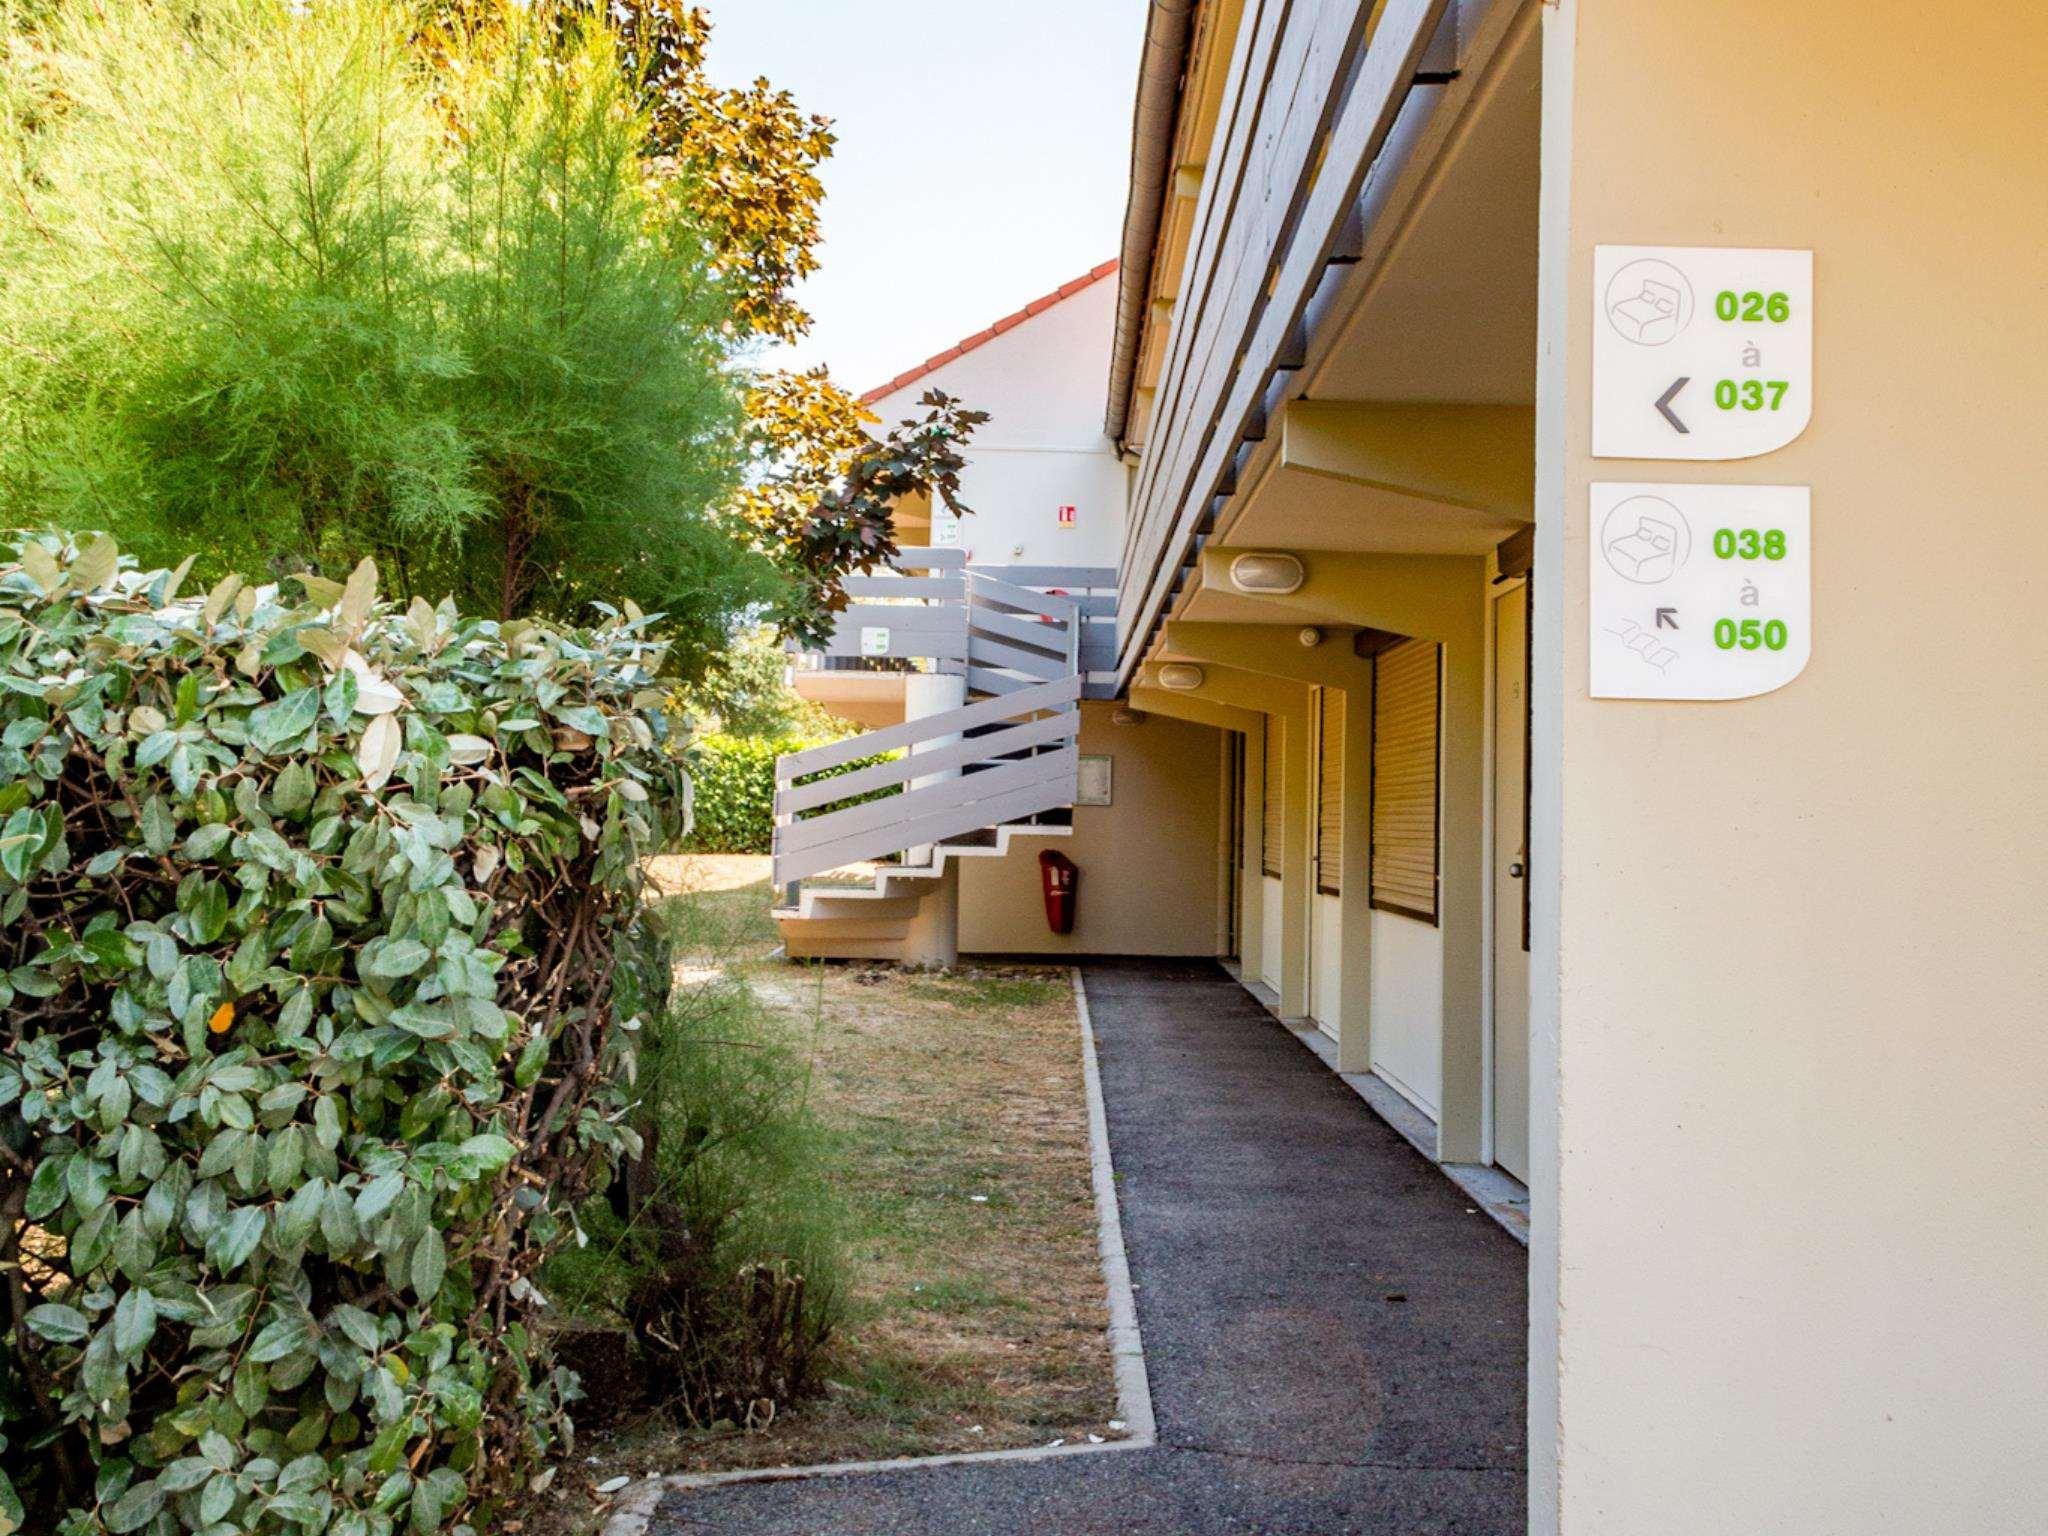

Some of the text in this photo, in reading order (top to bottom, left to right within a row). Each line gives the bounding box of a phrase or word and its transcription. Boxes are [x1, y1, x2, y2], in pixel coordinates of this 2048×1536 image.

[1714, 289, 1791, 325] 026
[1742, 340, 1761, 368] à
[1714, 379, 1789, 412] 037
[1713, 527, 1788, 562] 038
[1740, 578, 1760, 607] à
[1713, 617, 1789, 652] 050
